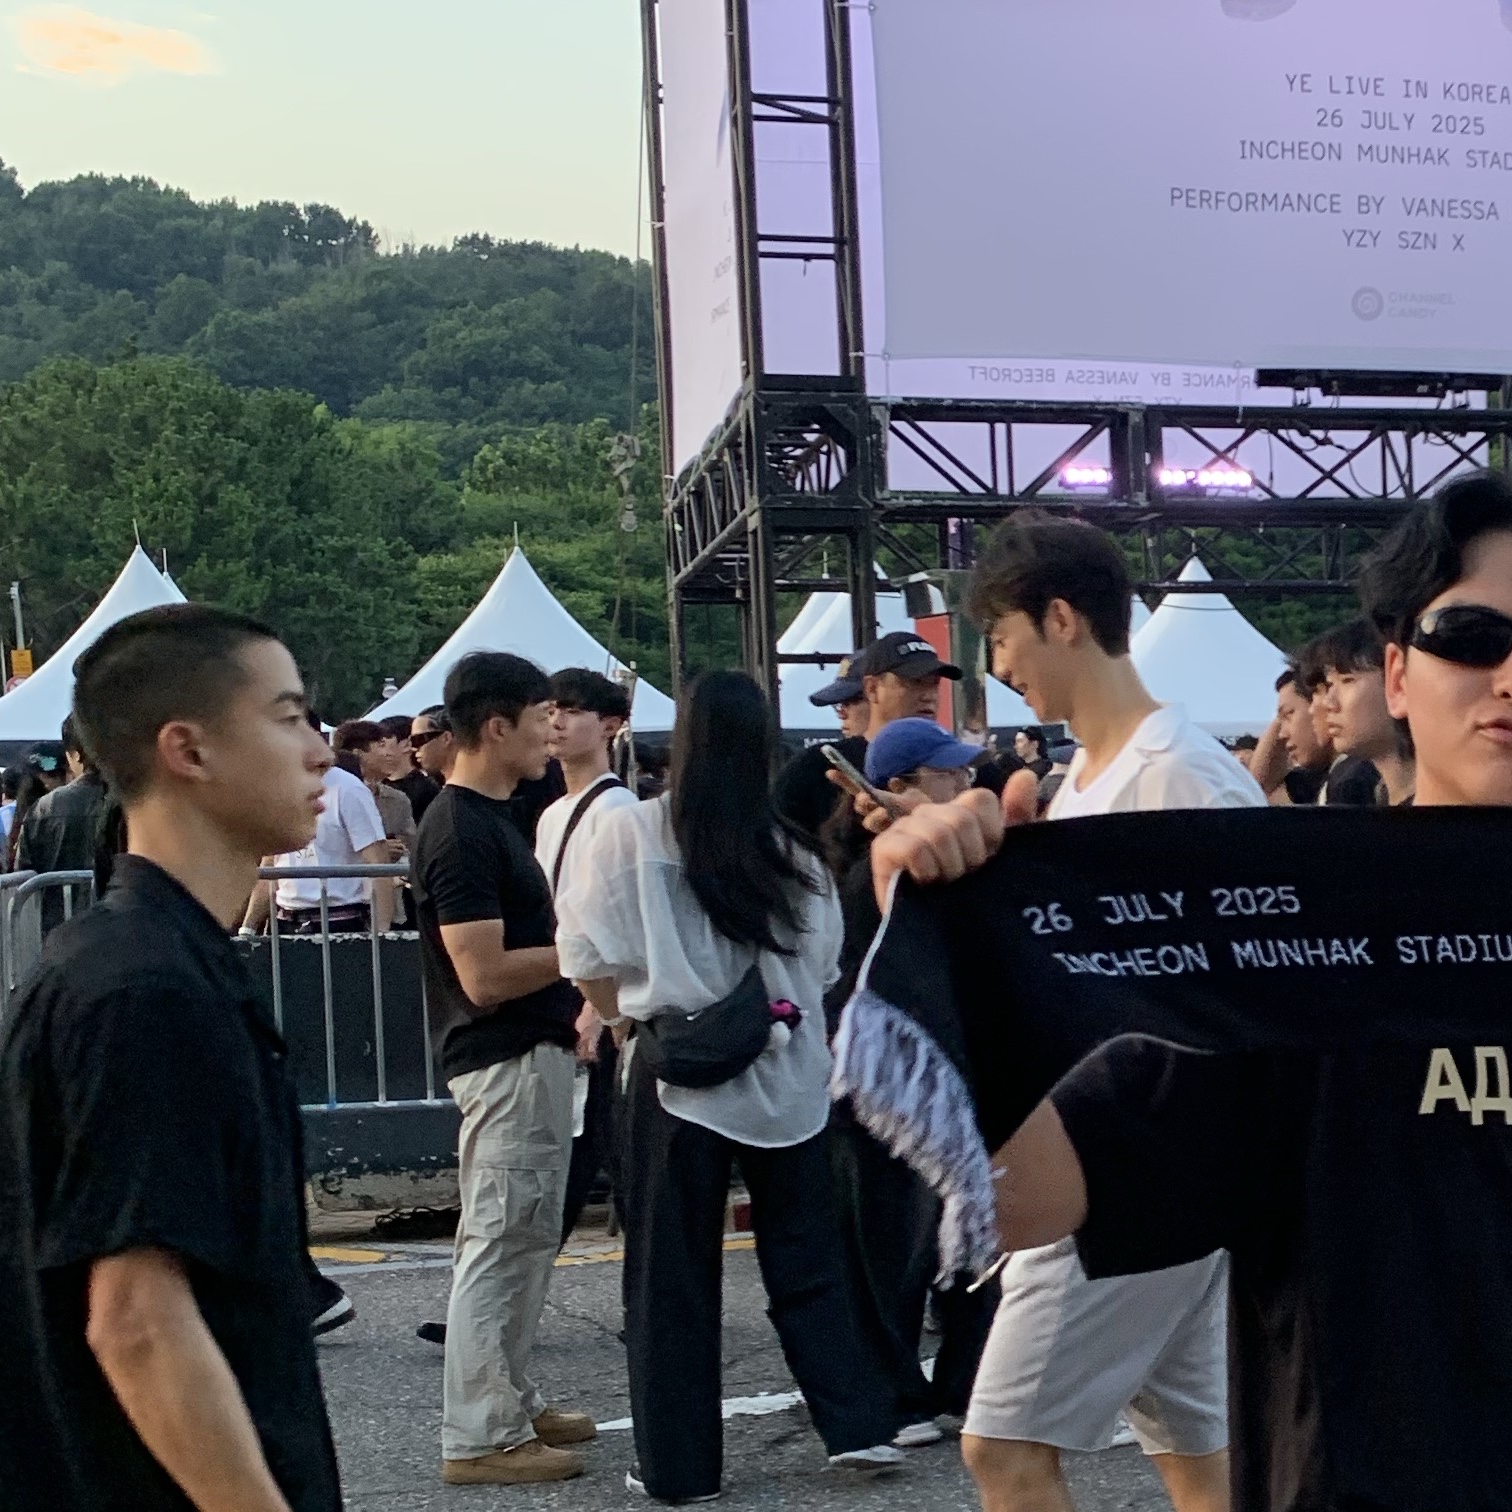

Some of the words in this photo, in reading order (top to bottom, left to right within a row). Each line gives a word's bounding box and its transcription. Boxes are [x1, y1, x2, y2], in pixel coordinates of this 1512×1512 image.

[1284, 74, 1312, 93] YE
[1328, 75, 1385, 96] LIVE
[1403, 79, 1428, 99] IN
[1443, 83, 1511, 104] KOREA
[1316, 108, 1343, 128] 26
[1361, 110, 1415, 131] JULY
[1431, 115, 1486, 135] 2025
[1239, 140, 1342, 161] INCHEON
[1357, 144, 1450, 167] MUNHAK
[1169, 187, 1342, 214] PERFORMANCE
[1357, 194, 1385, 215] BY
[1402, 197, 1499, 221] VANESSA
[1342, 229, 1381, 248] YZY
[1398, 231, 1437, 251] SZN
[1452, 234, 1465, 252] X
[1022, 902, 1074, 935] 26
[1098, 890, 1184, 925] JULY
[1210, 886, 1300, 916] 2025
[1052, 941, 1210, 976] INCHEON
[1231, 937, 1374, 970] MUNHAK
